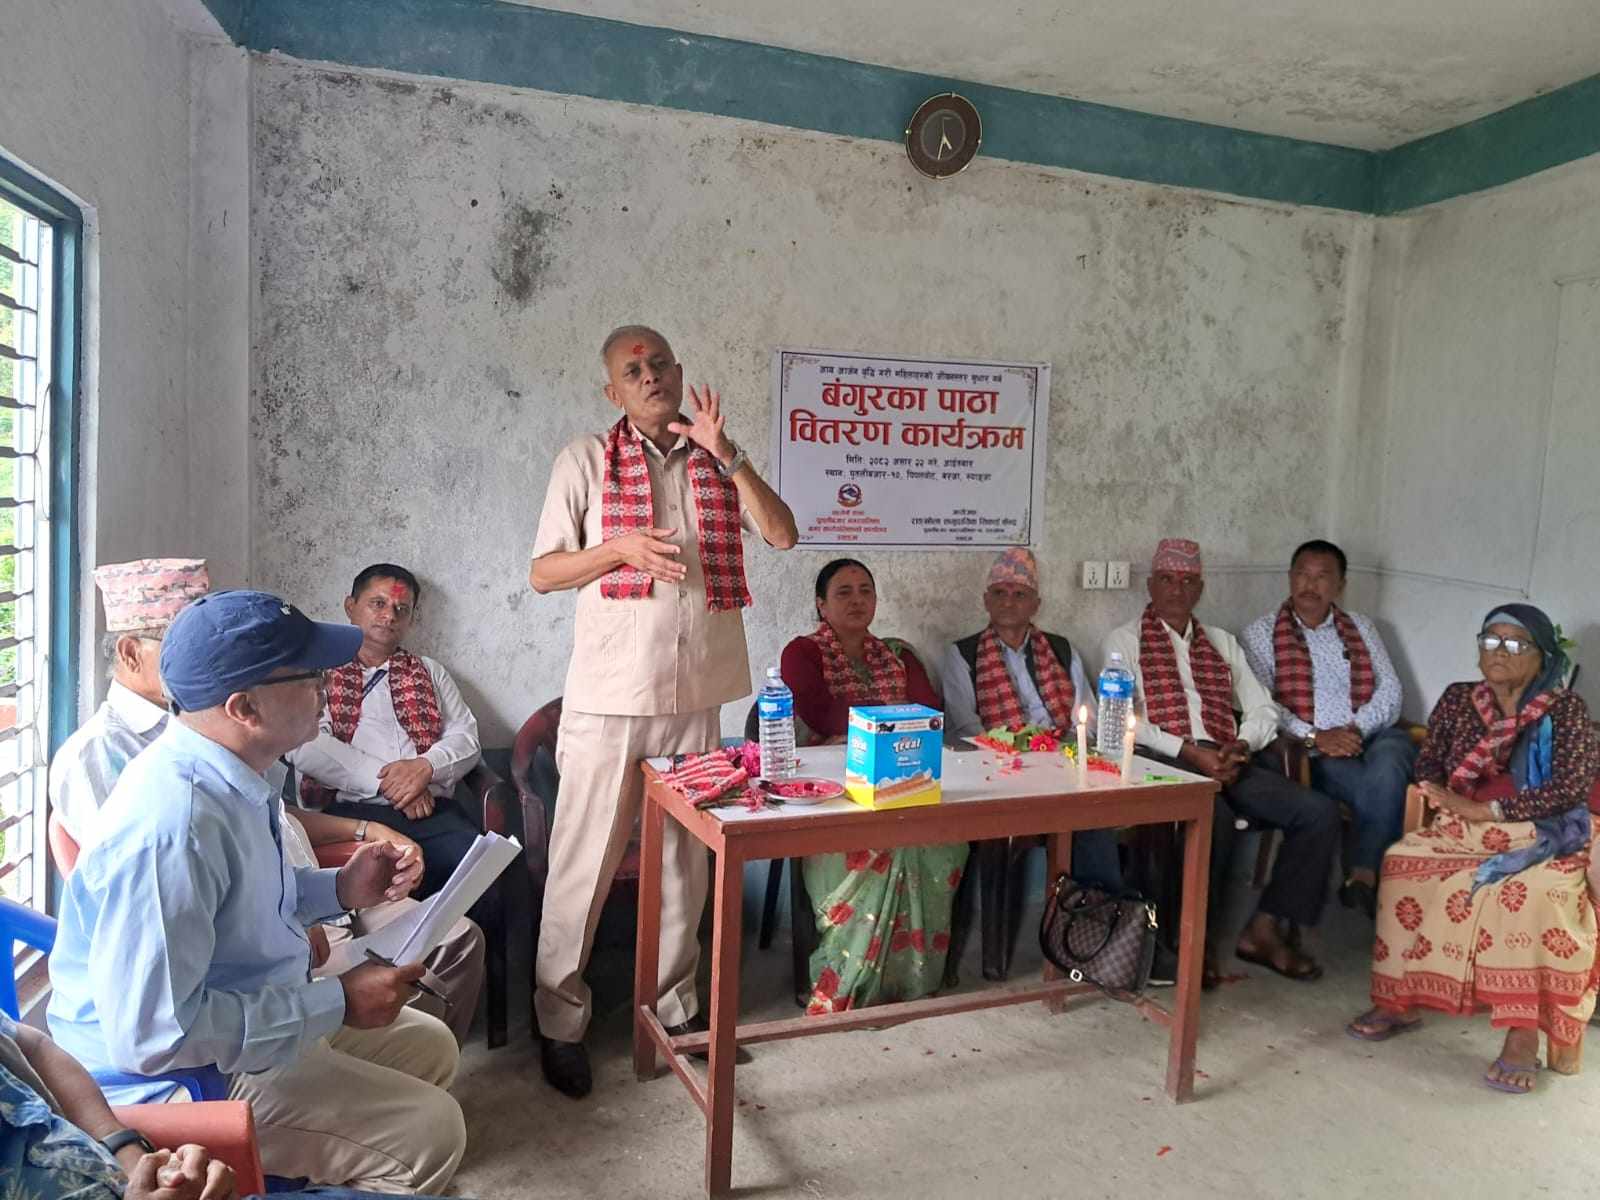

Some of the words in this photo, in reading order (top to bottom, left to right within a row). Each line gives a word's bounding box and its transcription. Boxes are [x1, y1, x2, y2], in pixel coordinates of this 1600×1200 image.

[821, 378, 928, 416] बंगुरका
[937, 389, 1000, 414] पाठा
[790, 409, 893, 446] वितरण
[901, 418, 1026, 450] कार्यक्रम
